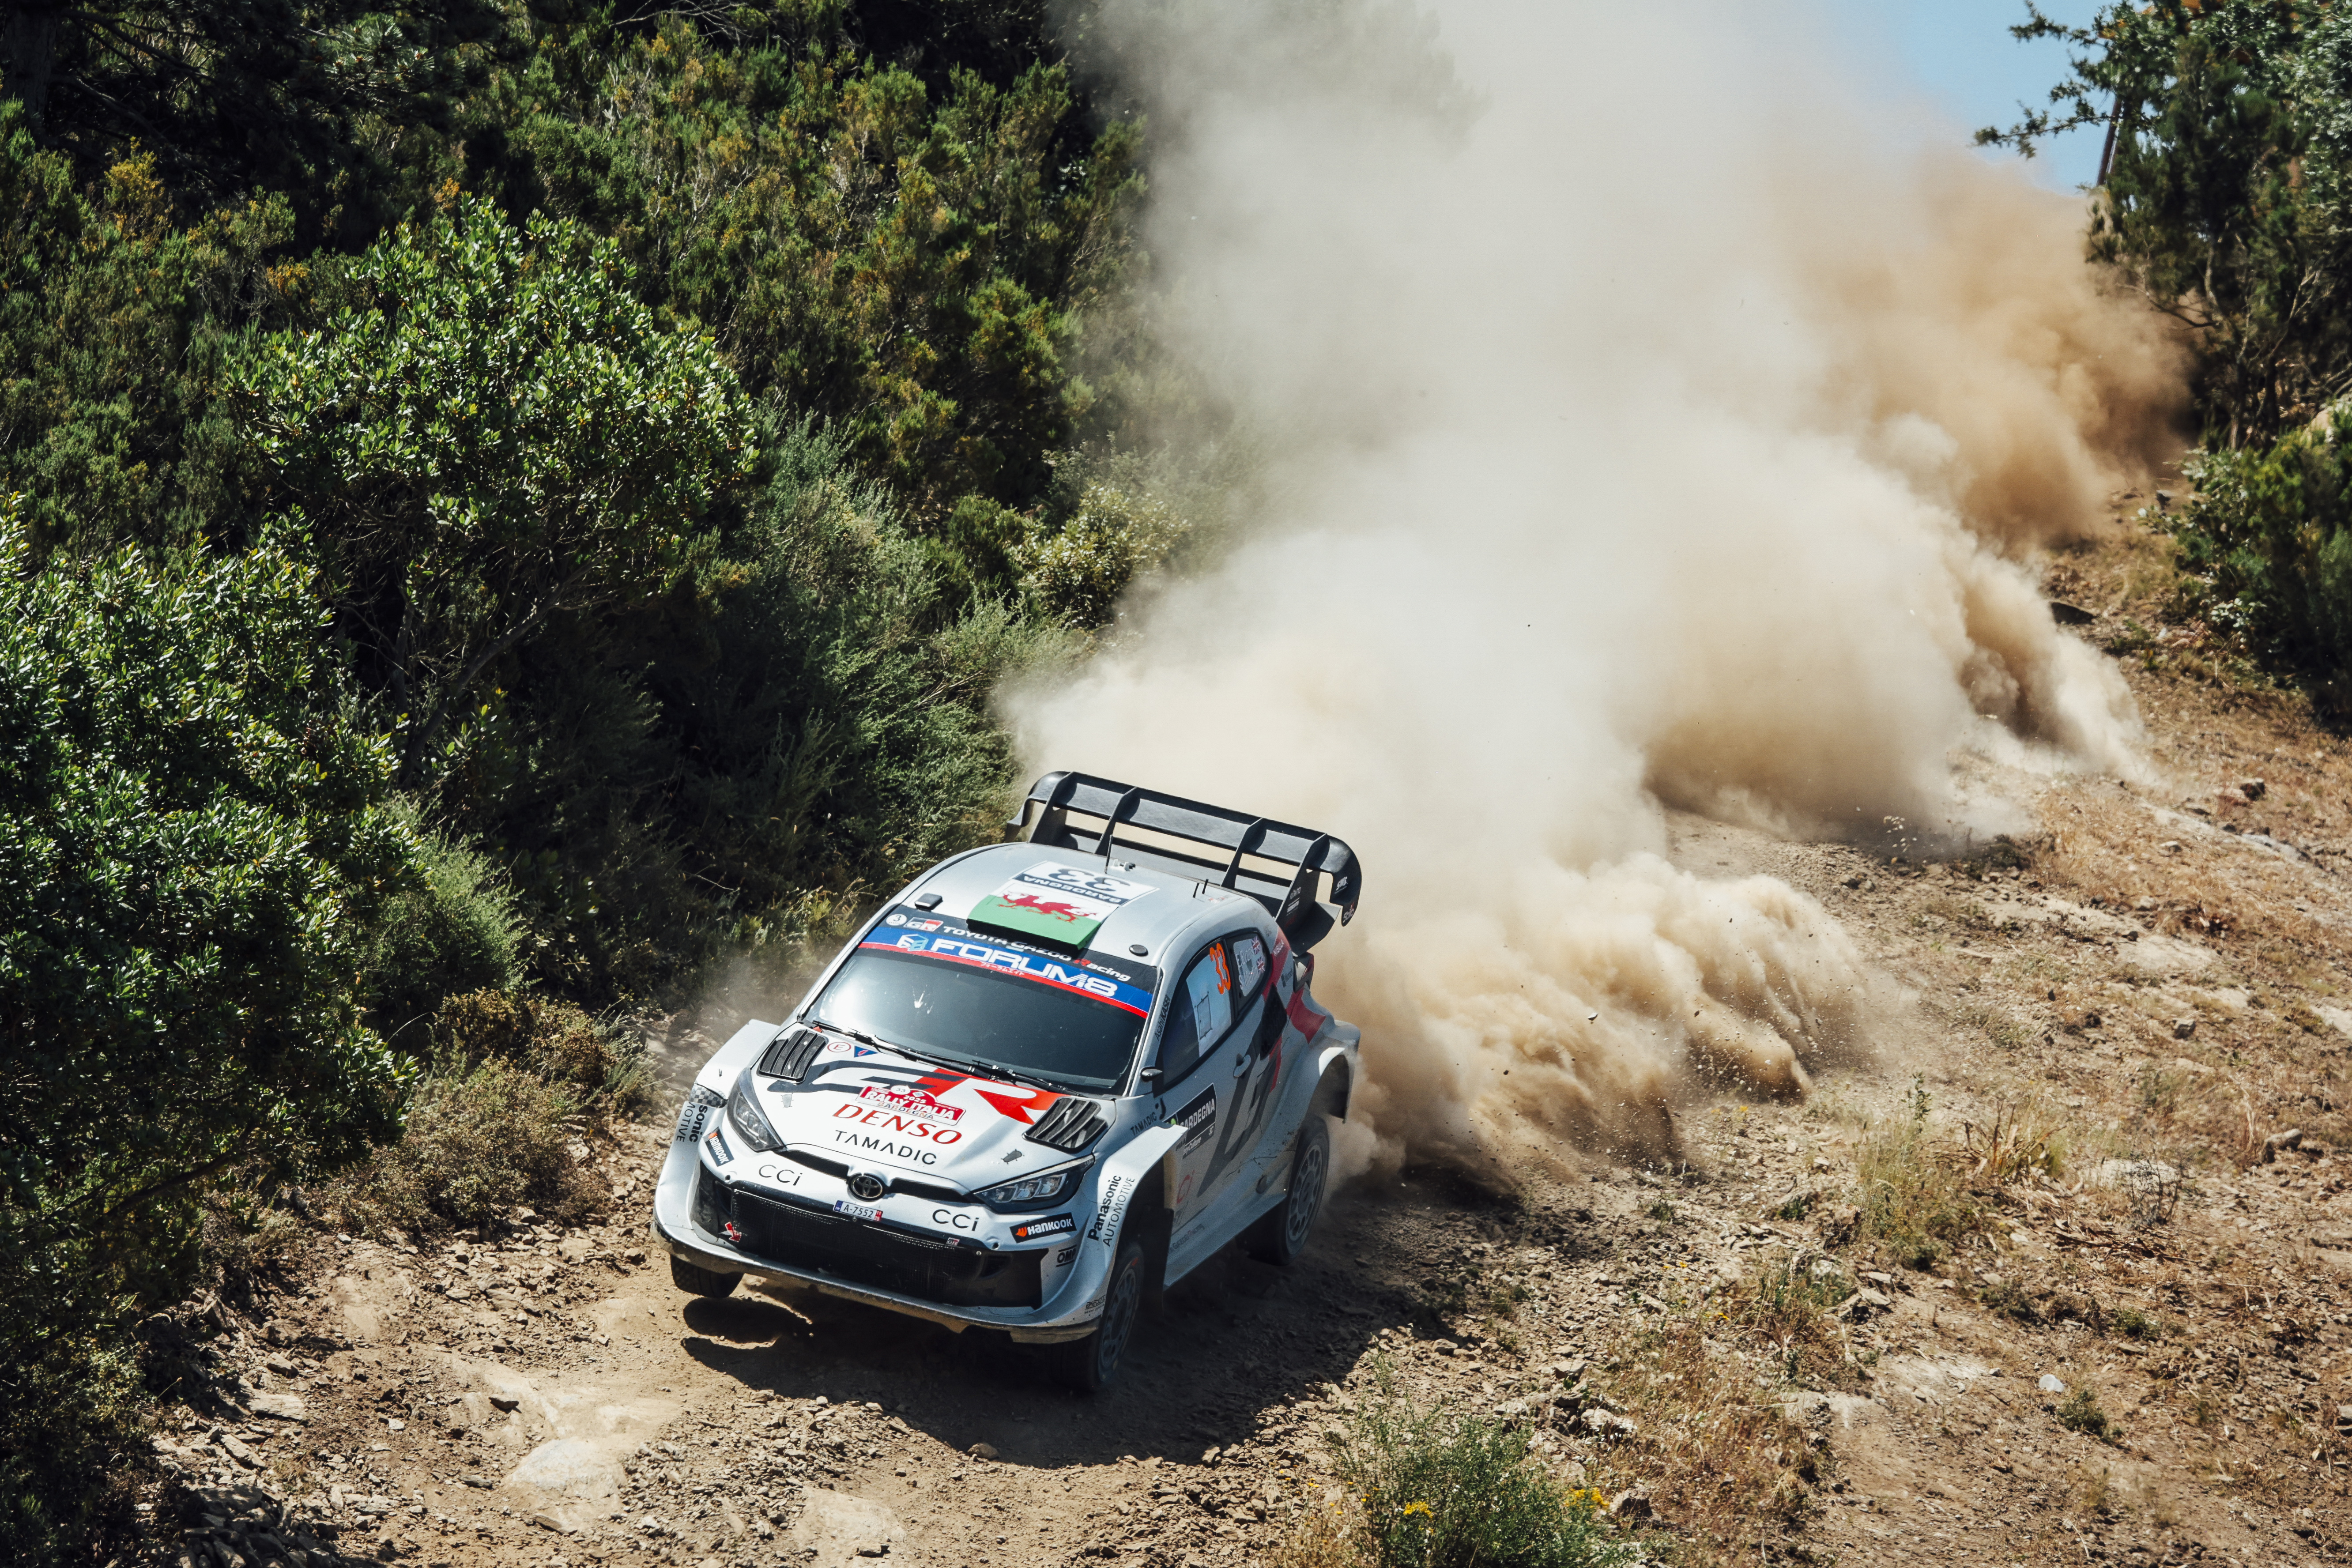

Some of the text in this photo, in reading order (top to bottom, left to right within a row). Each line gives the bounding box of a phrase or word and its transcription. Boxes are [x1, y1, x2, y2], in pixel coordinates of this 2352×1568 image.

[1024, 875, 1122, 904] SARDEGNA
[1048, 868, 1131, 892] 33
[930, 938, 1118, 997] FORUM8
[943, 926, 1131, 982] TOYOTA GAZOO Racing
[1210, 942, 1231, 995] 33
[1153, 994, 1170, 1042] AsahiKASEI
[864, 1091, 909, 1107] RALLY
[910, 1102, 955, 1120] ITALIA
[877, 1102, 934, 1119] SARDEGNA
[904, 1095, 927, 1104] 2025
[832, 1104, 963, 1145] DENSO
[1130, 1111, 1157, 1136] TAMADIC
[835, 1130, 937, 1165] TAMADIC
[844, 1204, 874, 1218] A-7552
[1087, 1175, 1121, 1241] Panasonic
[1102, 1177, 1135, 1247] AUTOMOTIVE
[1057, 1248, 1077, 1263] OMP
